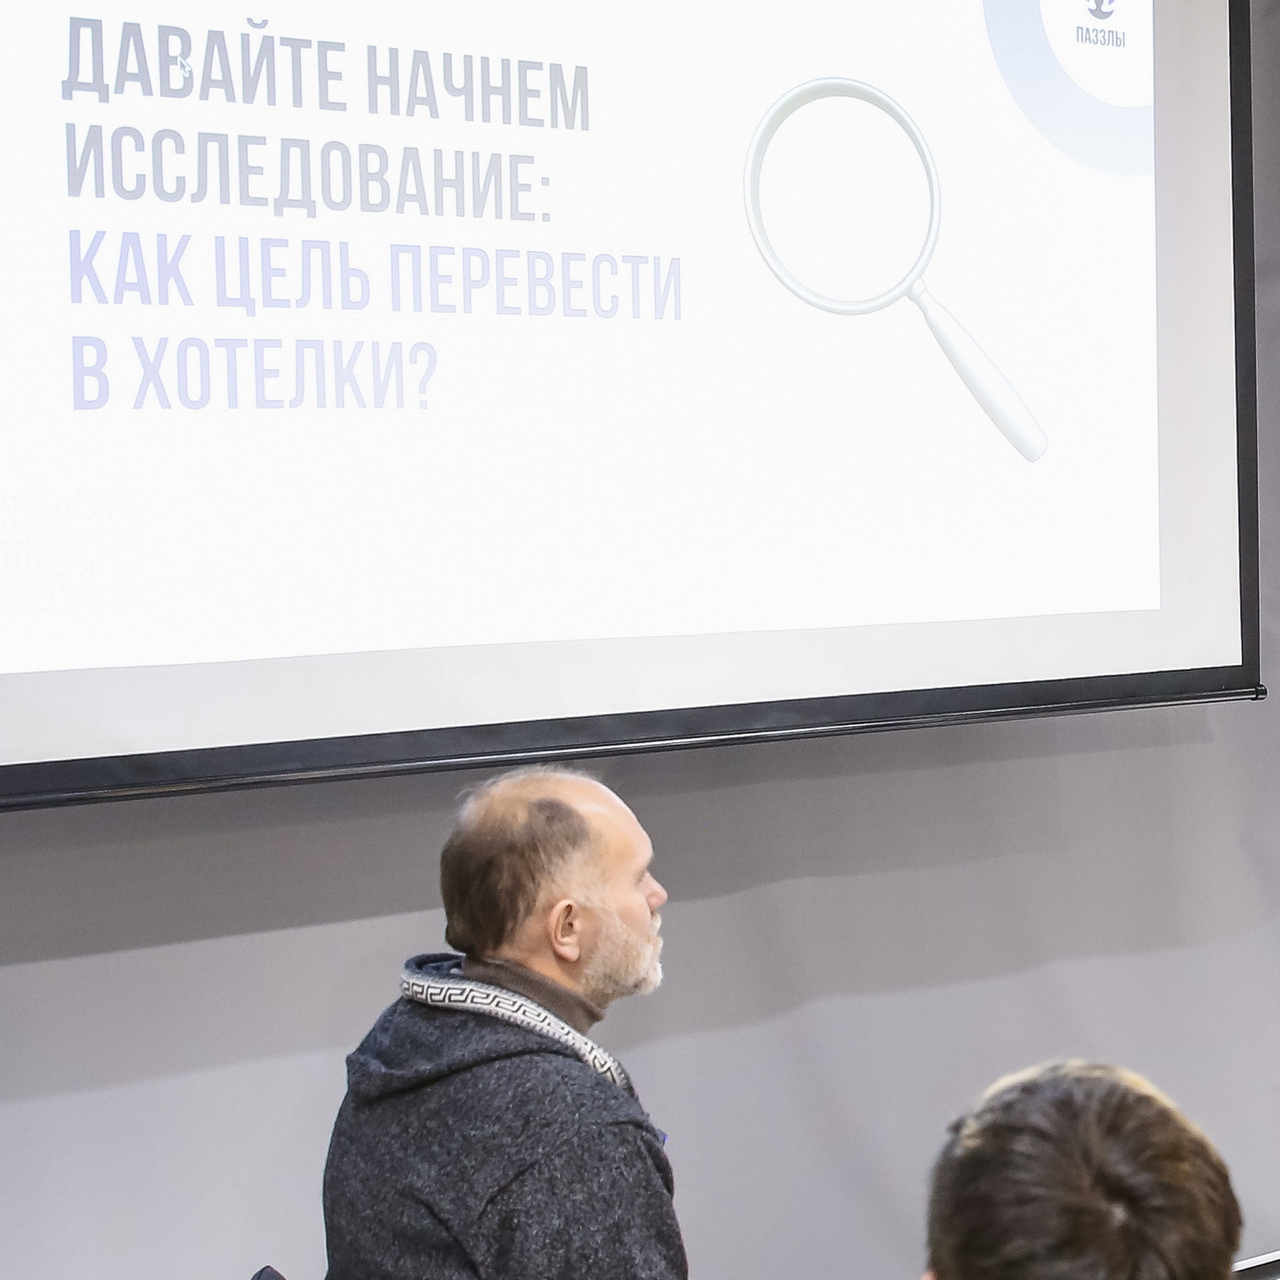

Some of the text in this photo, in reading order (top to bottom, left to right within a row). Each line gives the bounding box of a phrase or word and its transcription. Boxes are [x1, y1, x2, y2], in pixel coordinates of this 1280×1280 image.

[62, 16, 590, 131] ДАВАЙТЕ НАЧНЕМ
[1076, 26, 1126, 48] ПАЗЗЛЫ
[65, 122, 551, 222] ИССЛЕДОВАНИЕ:
[68, 229, 682, 321] КАК ЦЕЛЬ ПЕРЕВЕСТИ
[70, 335, 438, 411] В ХОТЕЛКИ?
